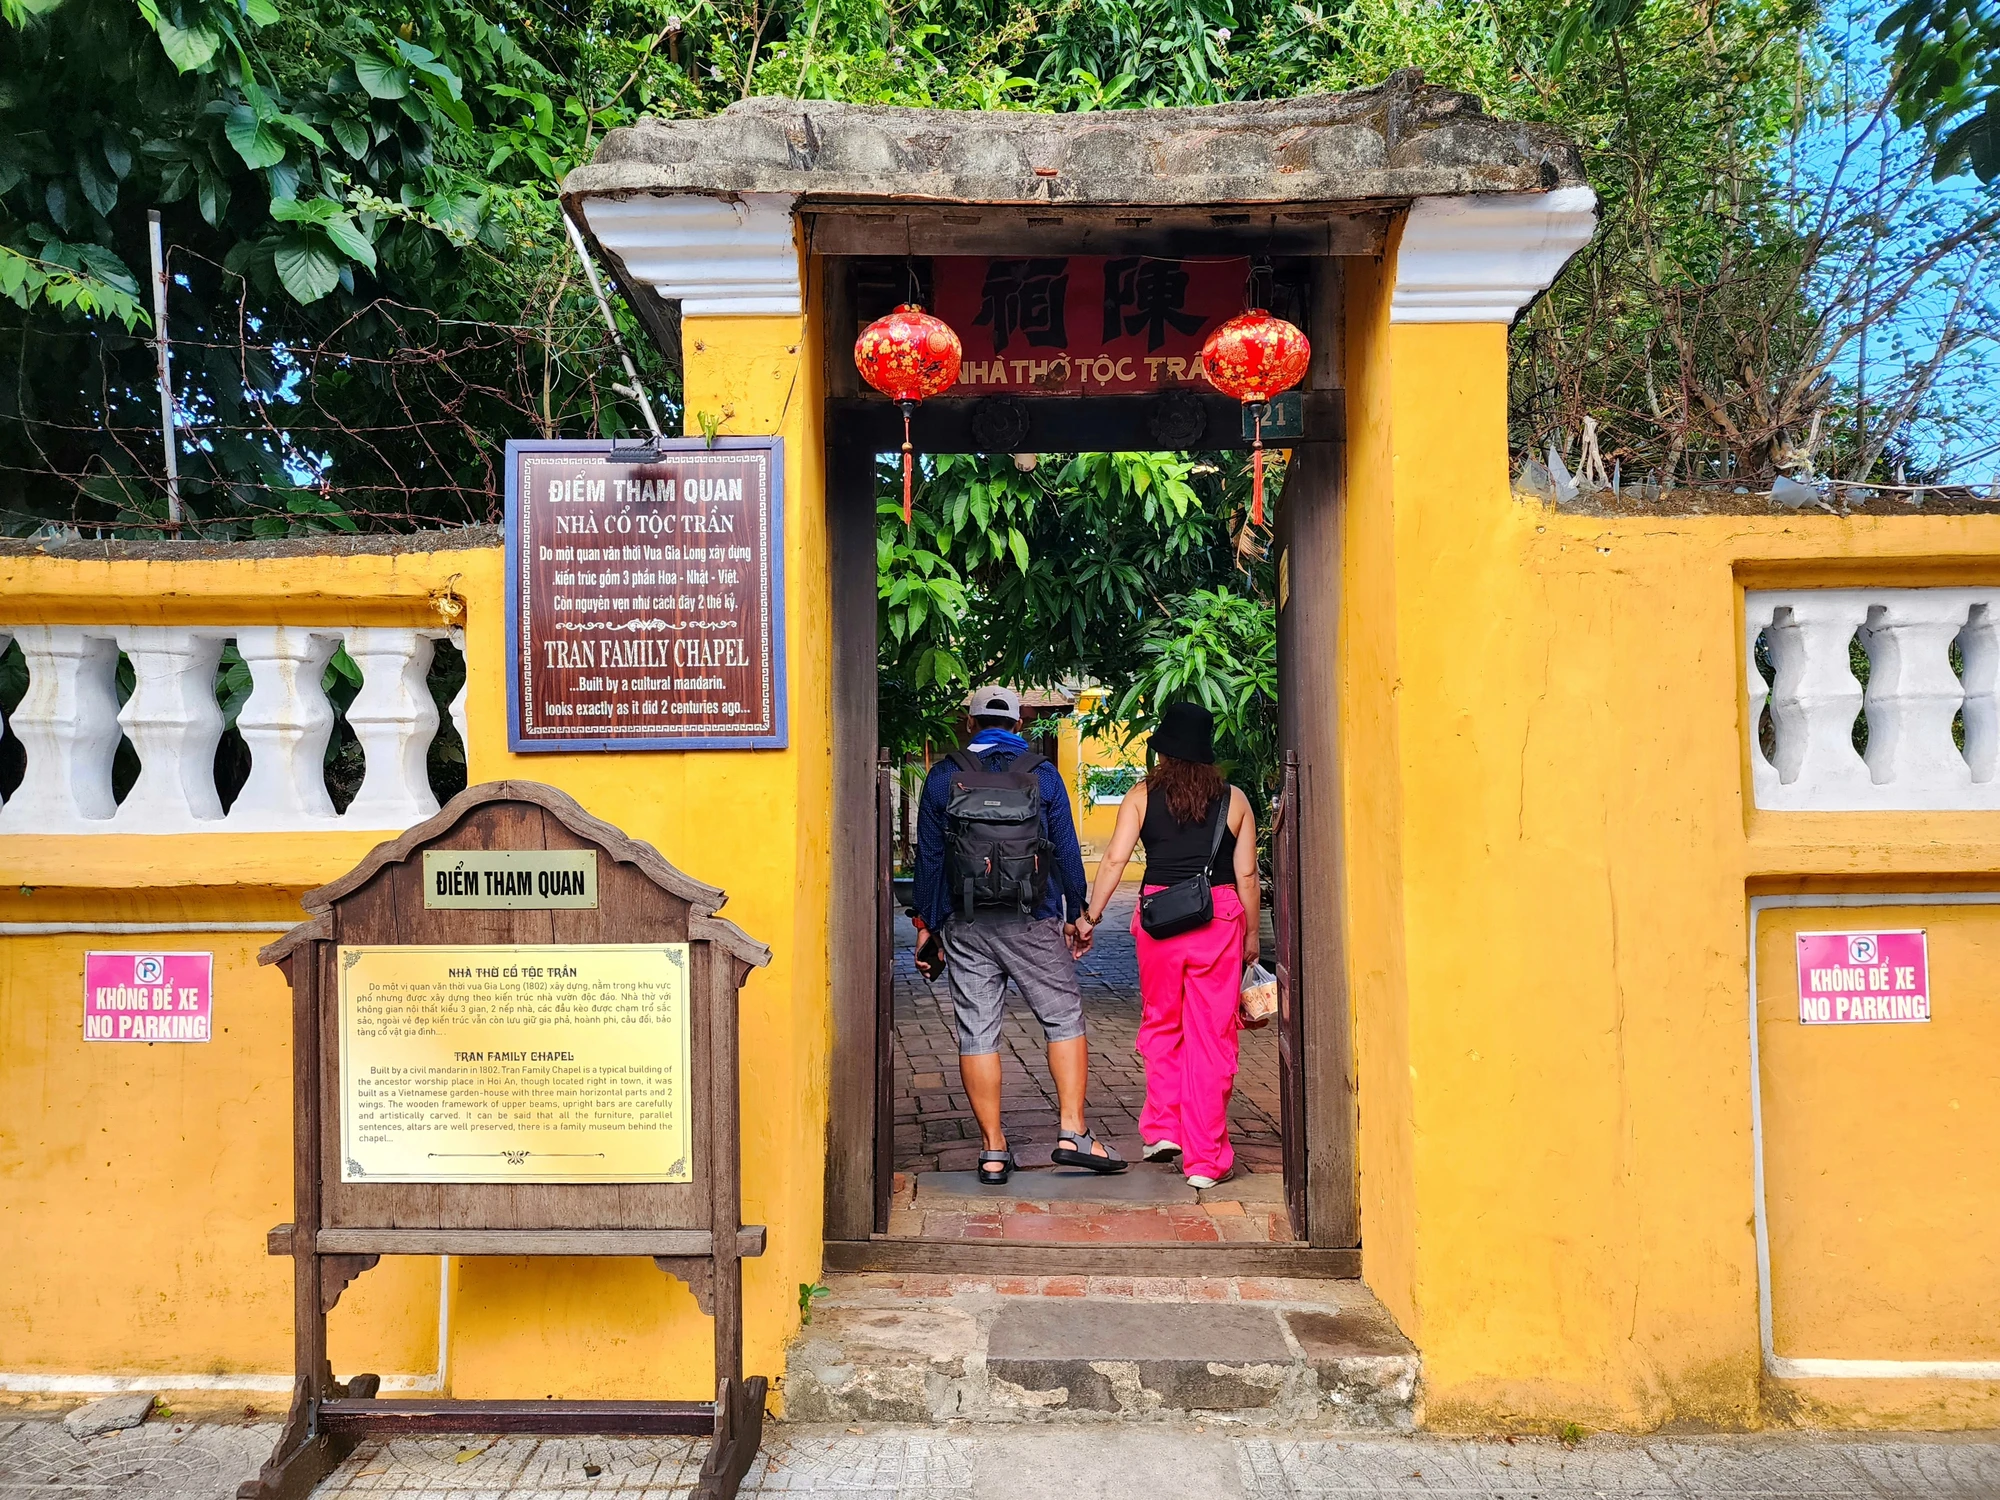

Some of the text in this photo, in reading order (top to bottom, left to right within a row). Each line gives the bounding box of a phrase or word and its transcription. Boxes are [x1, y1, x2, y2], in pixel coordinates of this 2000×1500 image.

[1010, 352, 1071, 384] THỜ
[1075, 353, 1137, 387] TỘC
[1261, 403, 1286, 426] 21
[548, 470, 742, 504] ĐIỂM THAM QUAN
[555, 505, 734, 539] NHÀ CỔ TỘC TRẦN
[539, 544, 750, 564] Do một quan văn thời Vua Gia Long xây dựng
[577, 570, 597, 585] trúc
[598, 568, 620, 588] gồm
[622, 569, 629, 585] 3
[631, 567, 655, 588] phần
[657, 569, 676, 584] Hoa
[686, 568, 708, 587] Nhật
[717, 568, 739, 587] Việt.
[553, 591, 738, 613] Còn nguyên vẹn như cách đây 2 thế kỷ.
[543, 638, 749, 668] TRAN FAMILY CHAPEL
[605, 676, 618, 694] by
[621, 678, 628, 690] a
[630, 675, 670, 690] cultural
[673, 675, 726, 690] mandarin.
[545, 701, 573, 715] looks
[576, 700, 613, 718] exactly
[616, 703, 629, 715] as
[631, 699, 639, 714] it
[641, 699, 658, 714] did
[660, 699, 668, 714] 2
[670, 699, 718, 714] centuries
[436, 861, 585, 898] ĐIỂM THAM QUAN
[448, 963, 576, 979] NHÀ THỜ CỔ TỘC TRẦN
[1810, 956, 1916, 992] KHÔNG ĐỂ XE
[96, 977, 198, 1011] KHÔNG ĐỂ XE
[1802, 995, 1926, 1021] NO PARKING
[87, 1015, 207, 1039] NO PARKING
[454, 1051, 574, 1062] TRAN FAMILY CHAPEL
[357, 1077, 371, 1085] the
[414, 1077, 448, 1087] worship
[451, 1077, 474, 1087] place
[476, 1077, 484, 1085] in
[487, 1076, 501, 1085] Hoi
[503, 1077, 518, 1086] An,
[520, 1077, 550, 1087] though
[552, 1076, 584, 1085] located
[586, 1076, 606, 1086] right
[609, 1076, 617, 1084] in
[620, 1077, 643, 1085] town,
[646, 1076, 651, 1084] it
[370, 1065, 389, 1074] Built
[391, 1066, 401, 1076] by
[409, 1065, 426, 1074] civil
[428, 1065, 468, 1074] mandarin
[469, 1065, 477, 1074] in
[479, 1065, 500, 1074] 1802.
[500, 1065, 520, 1074] Tran
[521, 1065, 550, 1076] Family
[551, 1065, 581, 1075] Chapel
[598, 1065, 627, 1075] typical
[628, 1065, 662, 1075] building
[663, 1065, 672, 1073] of
[357, 1088, 376, 1097] built
[397, 1088, 447, 1097] Vietnamese
[449, 1088, 509, 1098] garden-house
[511, 1088, 529, 1096] with
[531, 1088, 554, 1096] three
[556, 1088, 577, 1096] main
[579, 1087, 623, 1096] horizontal
[624, 1088, 647, 1097] parts
[649, 1088, 665, 1096] and
[667, 1087, 672, 1096] 2
[358, 1123, 404, 1131] sentences,
[406, 1122, 431, 1131] altars
[449, 1122, 468, 1130] well
[470, 1122, 515, 1132] preserved,
[517, 1122, 540, 1130] there
[542, 1122, 550, 1130] is
[560, 1121, 586, 1132] family
[627, 1121, 657, 1130] behind
[659, 1122, 673, 1130] the
